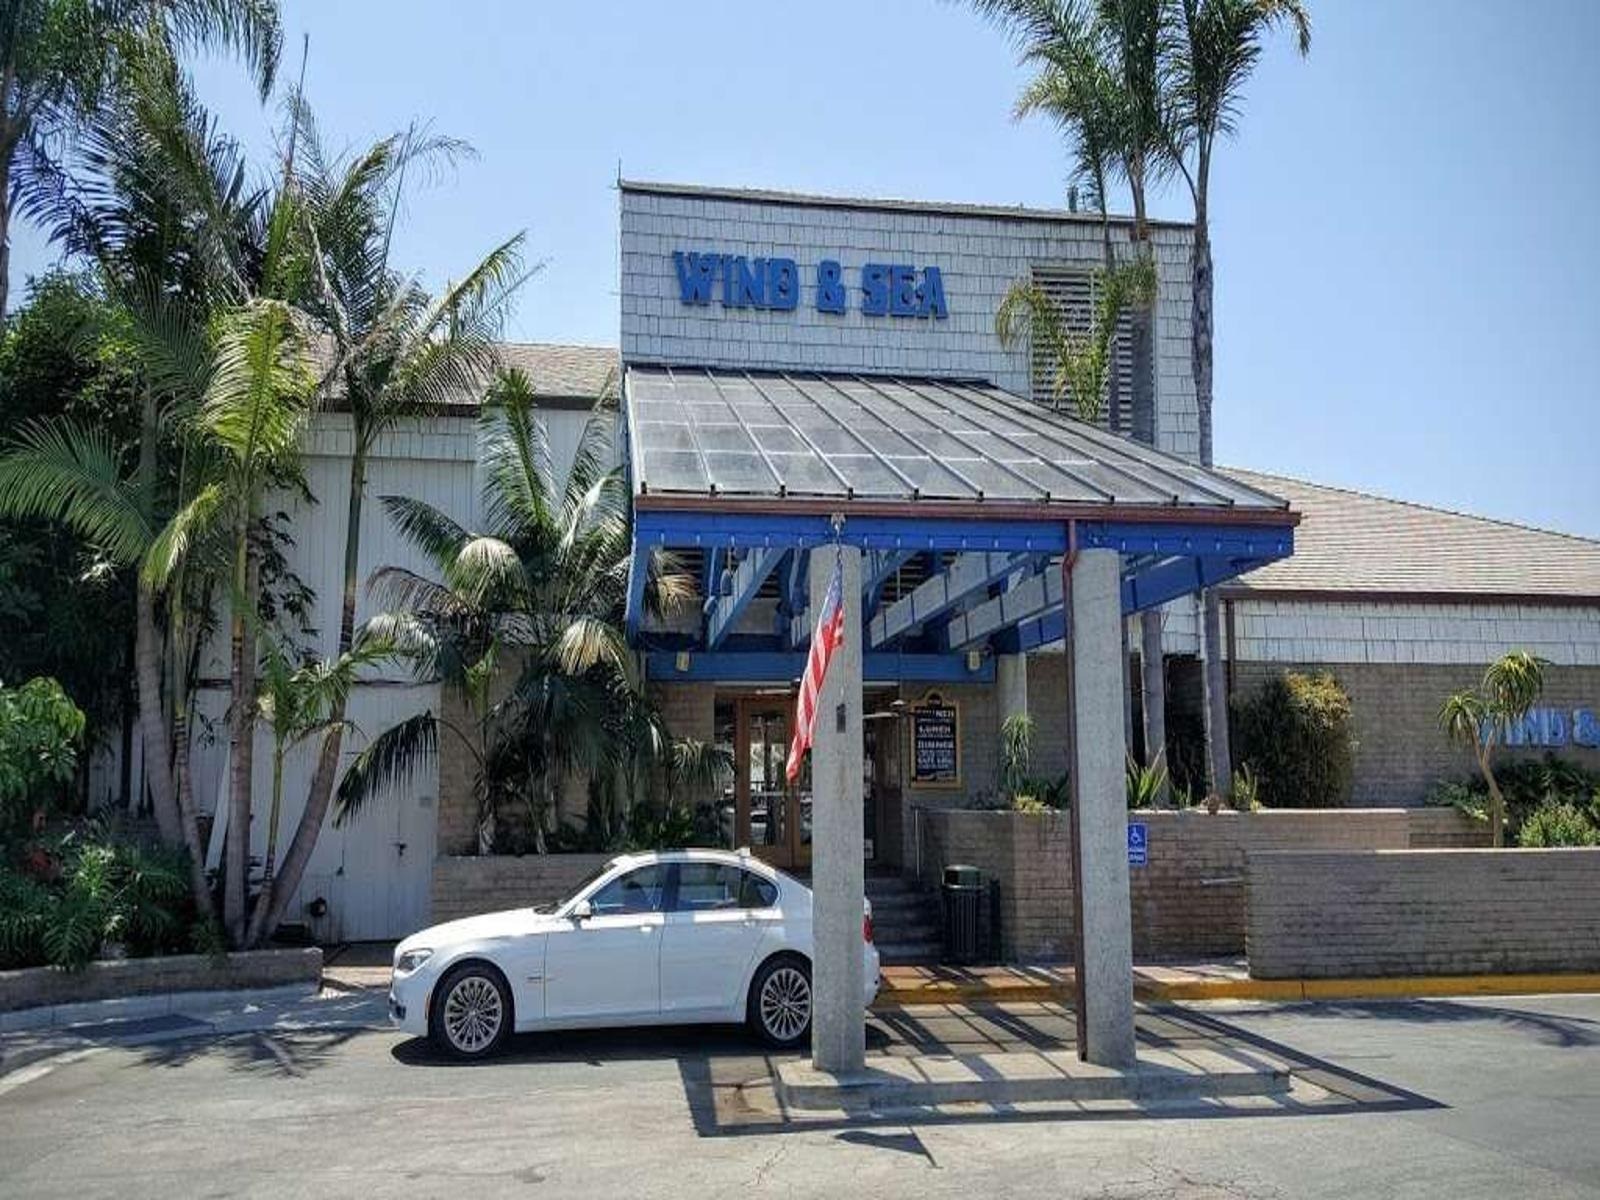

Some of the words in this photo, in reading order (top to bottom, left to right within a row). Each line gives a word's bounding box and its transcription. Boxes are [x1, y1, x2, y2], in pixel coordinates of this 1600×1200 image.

[672, 251, 799, 311] WIND
[816, 259, 847, 316] &
[861, 263, 949, 320] SEA
[1573, 708, 1600, 749] &
